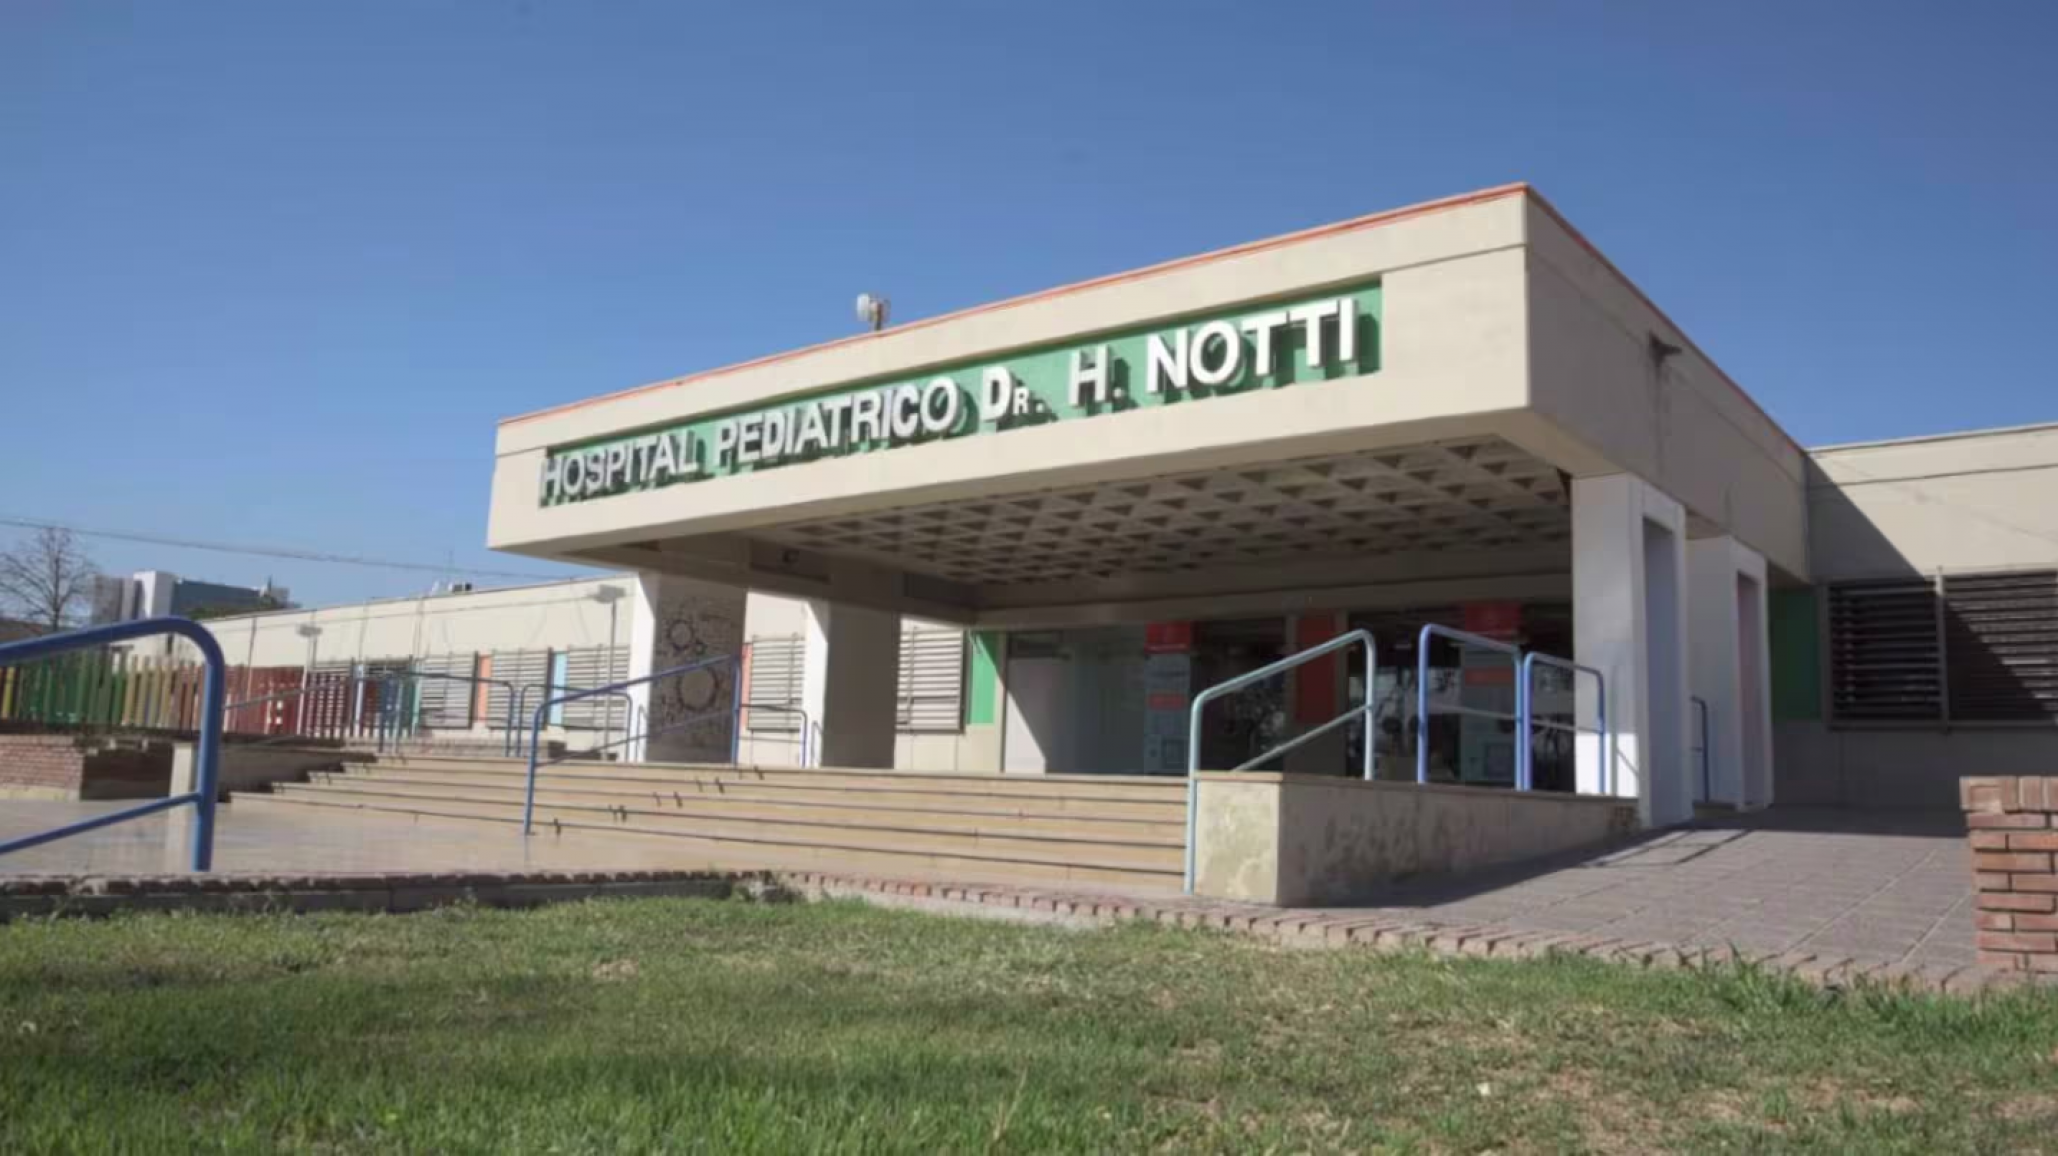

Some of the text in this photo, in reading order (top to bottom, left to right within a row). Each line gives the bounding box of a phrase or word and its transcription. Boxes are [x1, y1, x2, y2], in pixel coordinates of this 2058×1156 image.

[541, 430, 699, 498] HOSPITAL
[715, 376, 959, 461] PEDIATRICO
[1069, 344, 1125, 406] H.
[1146, 298, 1357, 394] NOTTI
